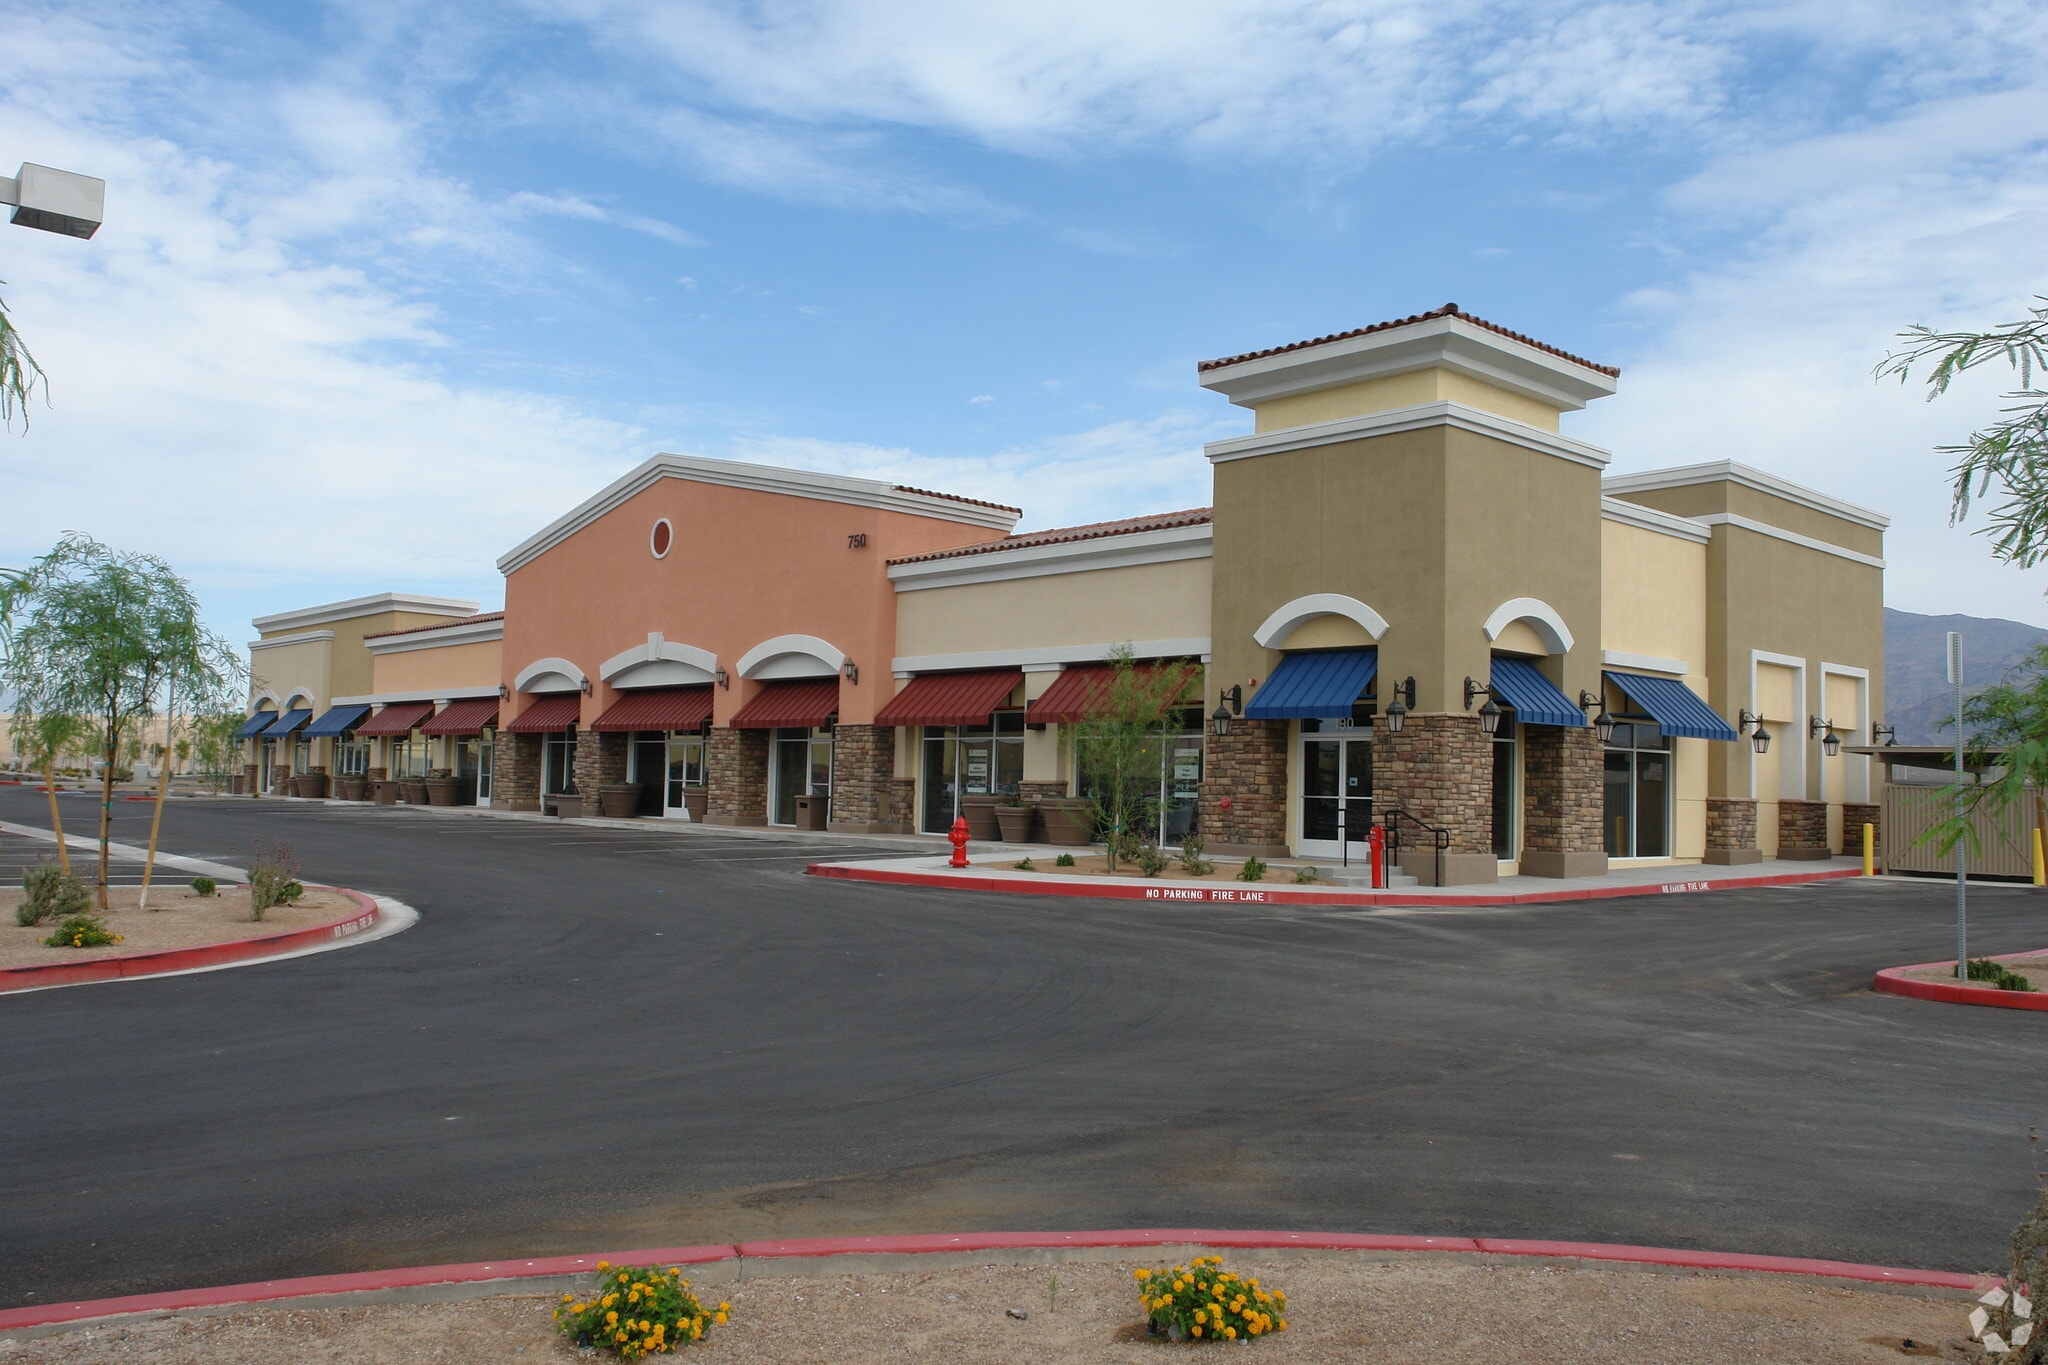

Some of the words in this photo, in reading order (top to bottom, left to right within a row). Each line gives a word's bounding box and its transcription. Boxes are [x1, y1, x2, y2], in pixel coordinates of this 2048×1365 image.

[848, 533, 866, 549] 750
[1146, 889, 1159, 898] NO
[1164, 889, 1203, 899] PARKING
[1212, 890, 1234, 900] FIRE
[1240, 891, 1264, 901] LANE
